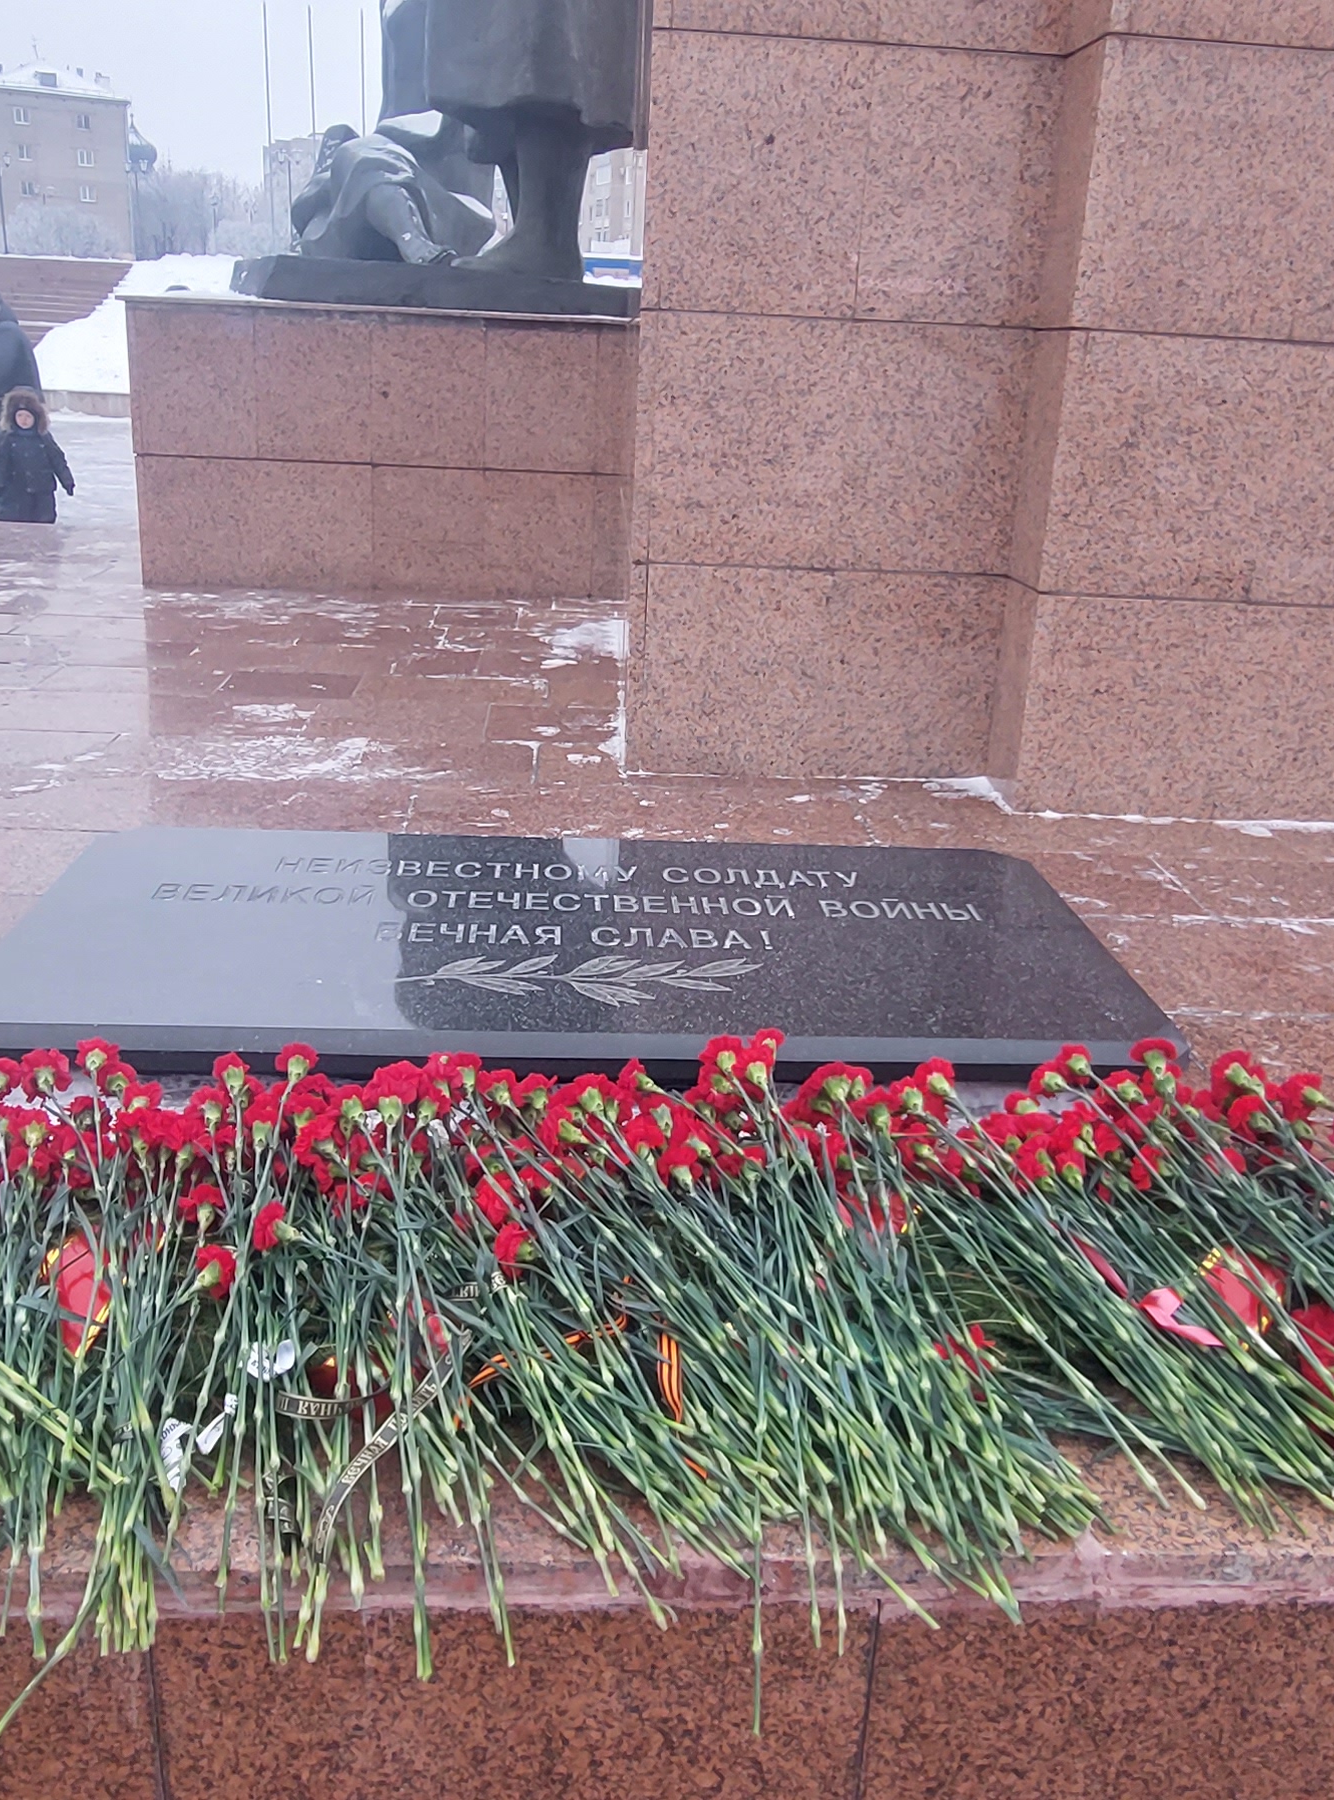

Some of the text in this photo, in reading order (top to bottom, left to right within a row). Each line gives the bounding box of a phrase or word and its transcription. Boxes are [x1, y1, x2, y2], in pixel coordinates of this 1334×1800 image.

[274, 855, 858, 890] НЕИЗВЕСТНОМУ СОЛДАТУ
[150, 882, 985, 922] ВЕЛИКОЙ ОТЕЧЕСТВЕННОЙ ВОЙНЫ
[374, 920, 774, 950] ВЕЧНАЯ СЛАВА!
